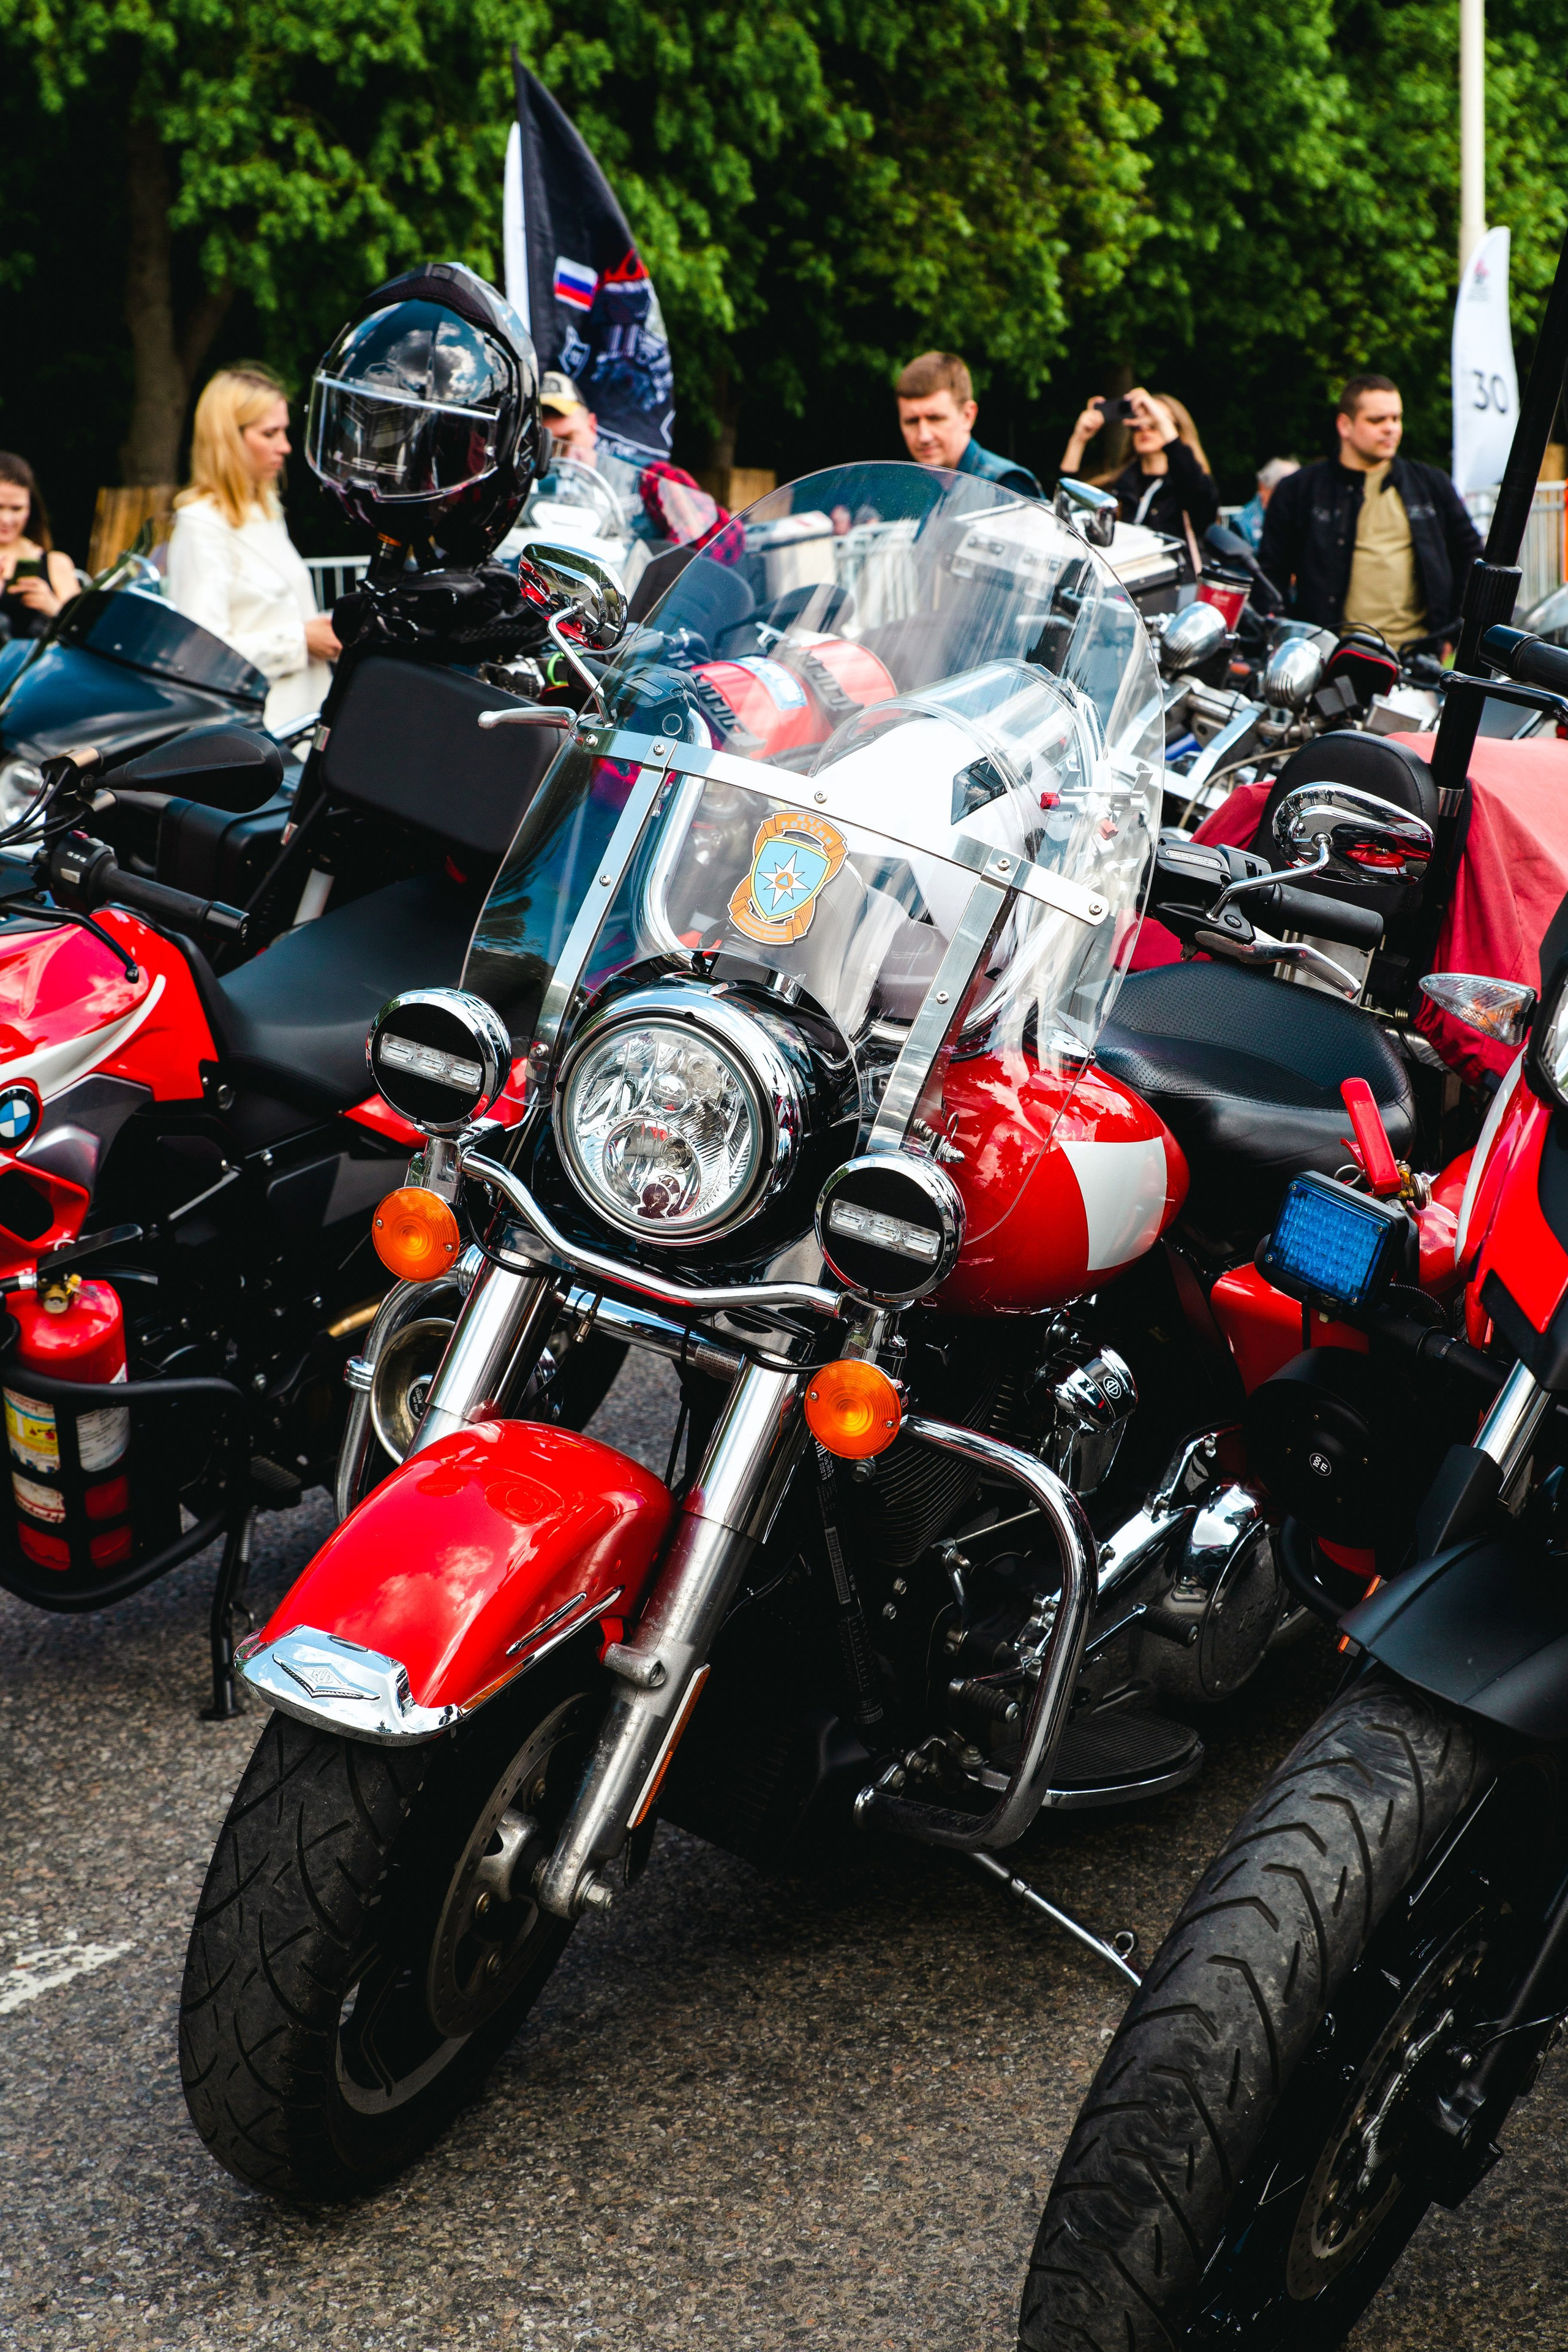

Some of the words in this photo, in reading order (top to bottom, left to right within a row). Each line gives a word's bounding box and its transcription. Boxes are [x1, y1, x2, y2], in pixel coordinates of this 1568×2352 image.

[1473, 369, 1509, 415] 30
[333, 450, 407, 476] LS2
[797, 815, 824, 828] МЧС
[781, 821, 833, 845] РОССИИ
[1313, 1456, 1321, 1468] 100
[1320, 1462, 1328, 1472] E
